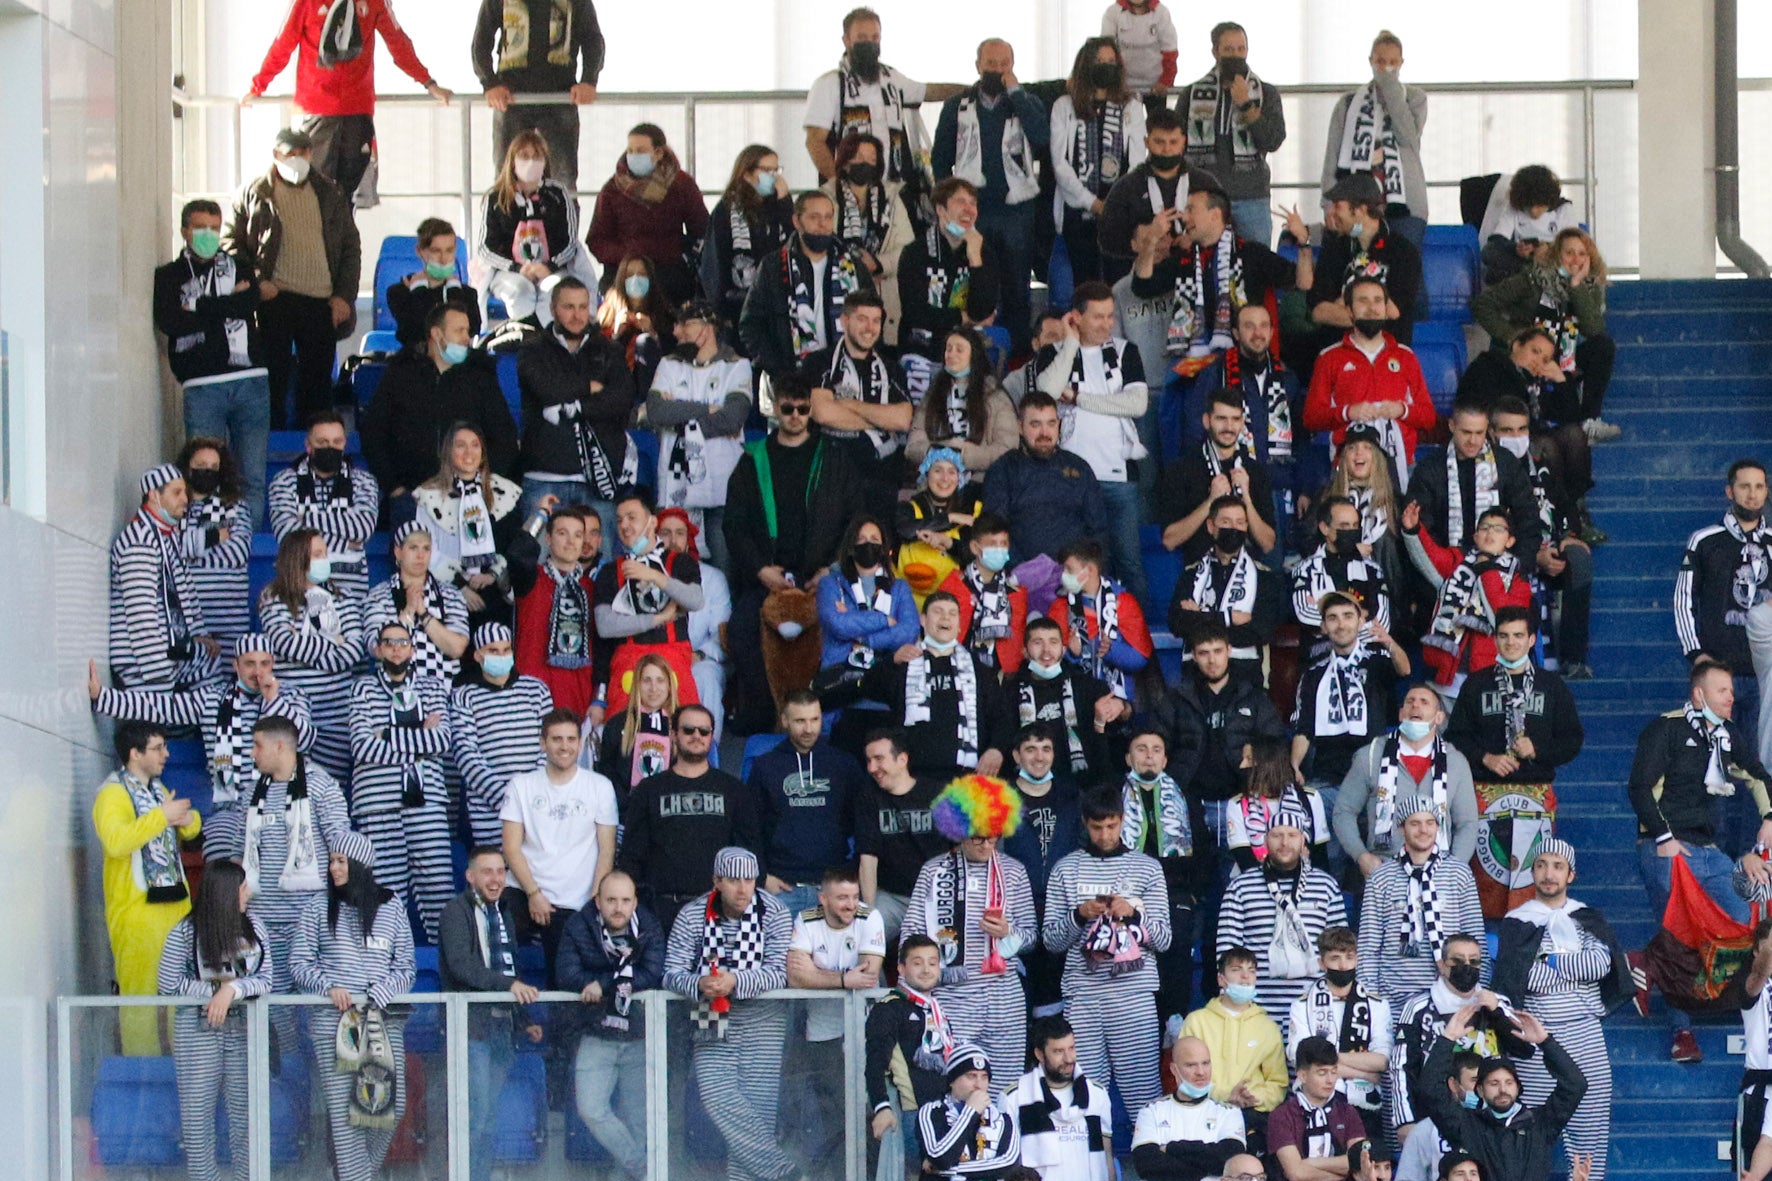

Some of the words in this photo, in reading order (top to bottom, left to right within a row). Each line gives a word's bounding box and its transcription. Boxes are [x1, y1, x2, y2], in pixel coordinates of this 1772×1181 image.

[1501, 799, 1529, 810] CLUB
[1477, 827, 1503, 879] BURGOS
[937, 872, 955, 930] BURGOS
